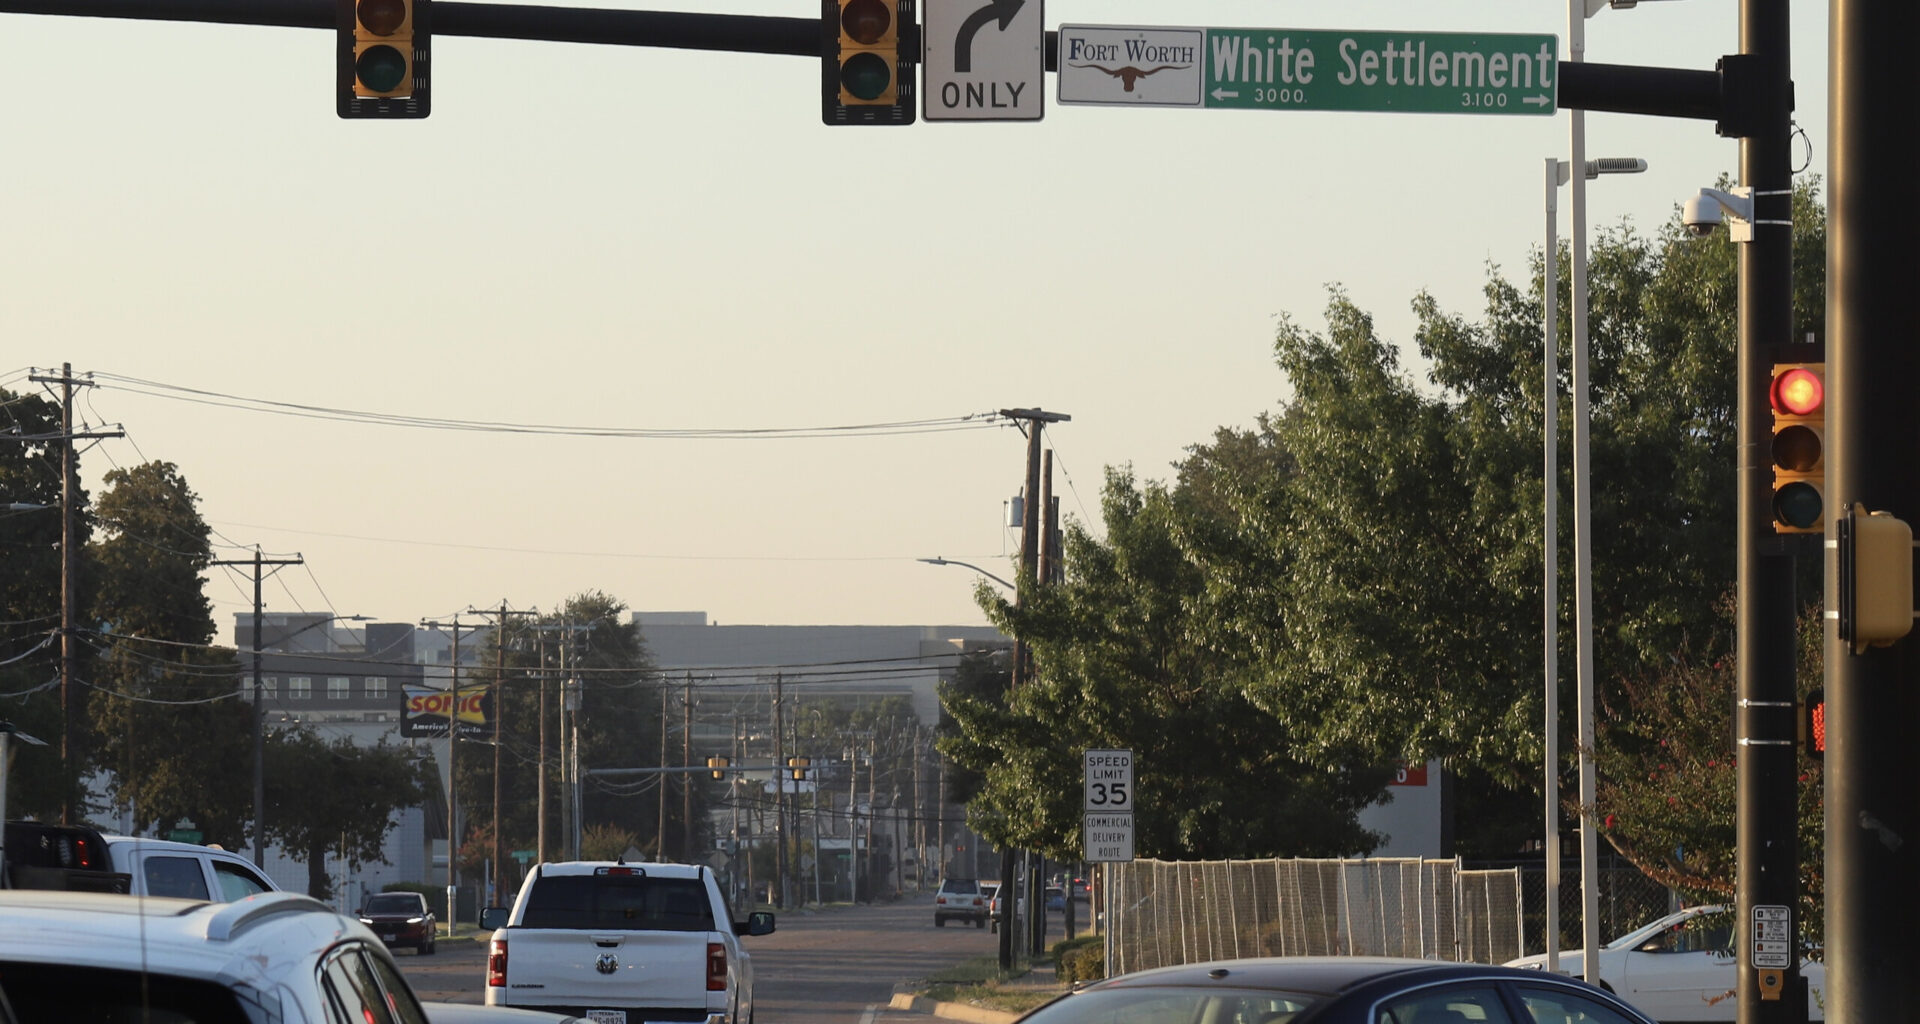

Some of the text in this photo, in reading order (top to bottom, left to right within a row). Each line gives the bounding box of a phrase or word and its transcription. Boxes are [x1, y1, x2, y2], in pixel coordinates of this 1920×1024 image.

[1068, 38, 1194, 63] FORT WORTH
[1212, 35, 1552, 89] White Settlement
[941, 81, 1026, 109] ONLY
[1089, 757, 1129, 767] SPEED
[1093, 770, 1124, 779] LIMIT
[1090, 783, 1127, 805] 35
[1087, 818, 1131, 828] COMMERCIAL
[1093, 833, 1126, 842] DELIVERY
[1099, 848, 1120, 857] ROUTE
